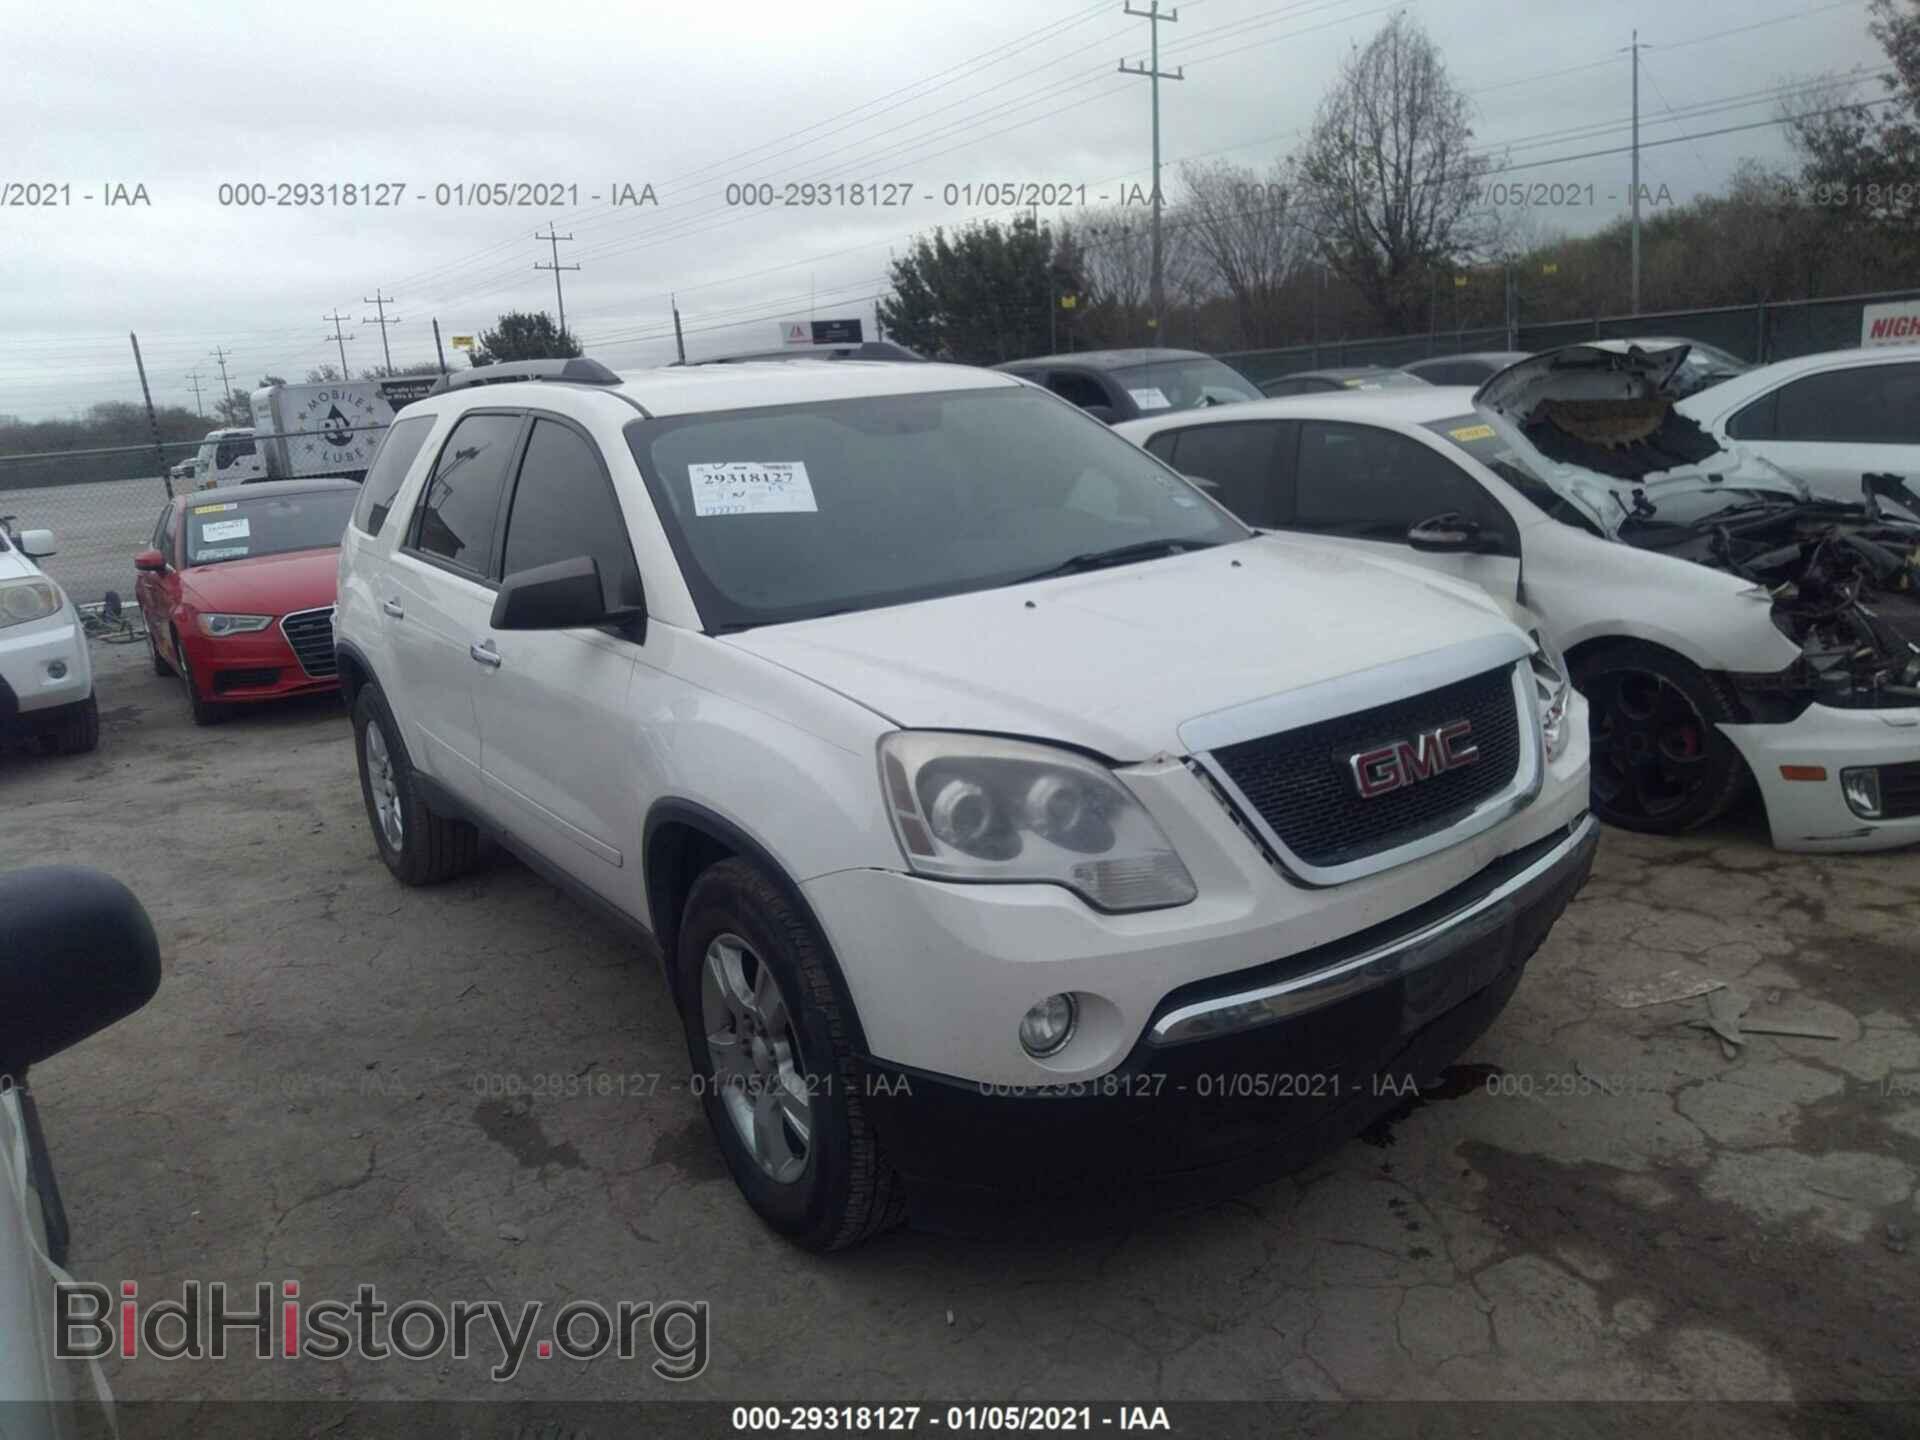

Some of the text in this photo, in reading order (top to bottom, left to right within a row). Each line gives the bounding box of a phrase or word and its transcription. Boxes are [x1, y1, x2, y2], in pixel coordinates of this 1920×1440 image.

[307, 389, 365, 411] MOBILE
[322, 447, 364, 463] LUBE
[704, 472, 793, 485] 29318127
[1350, 720, 1480, 798] GMC
